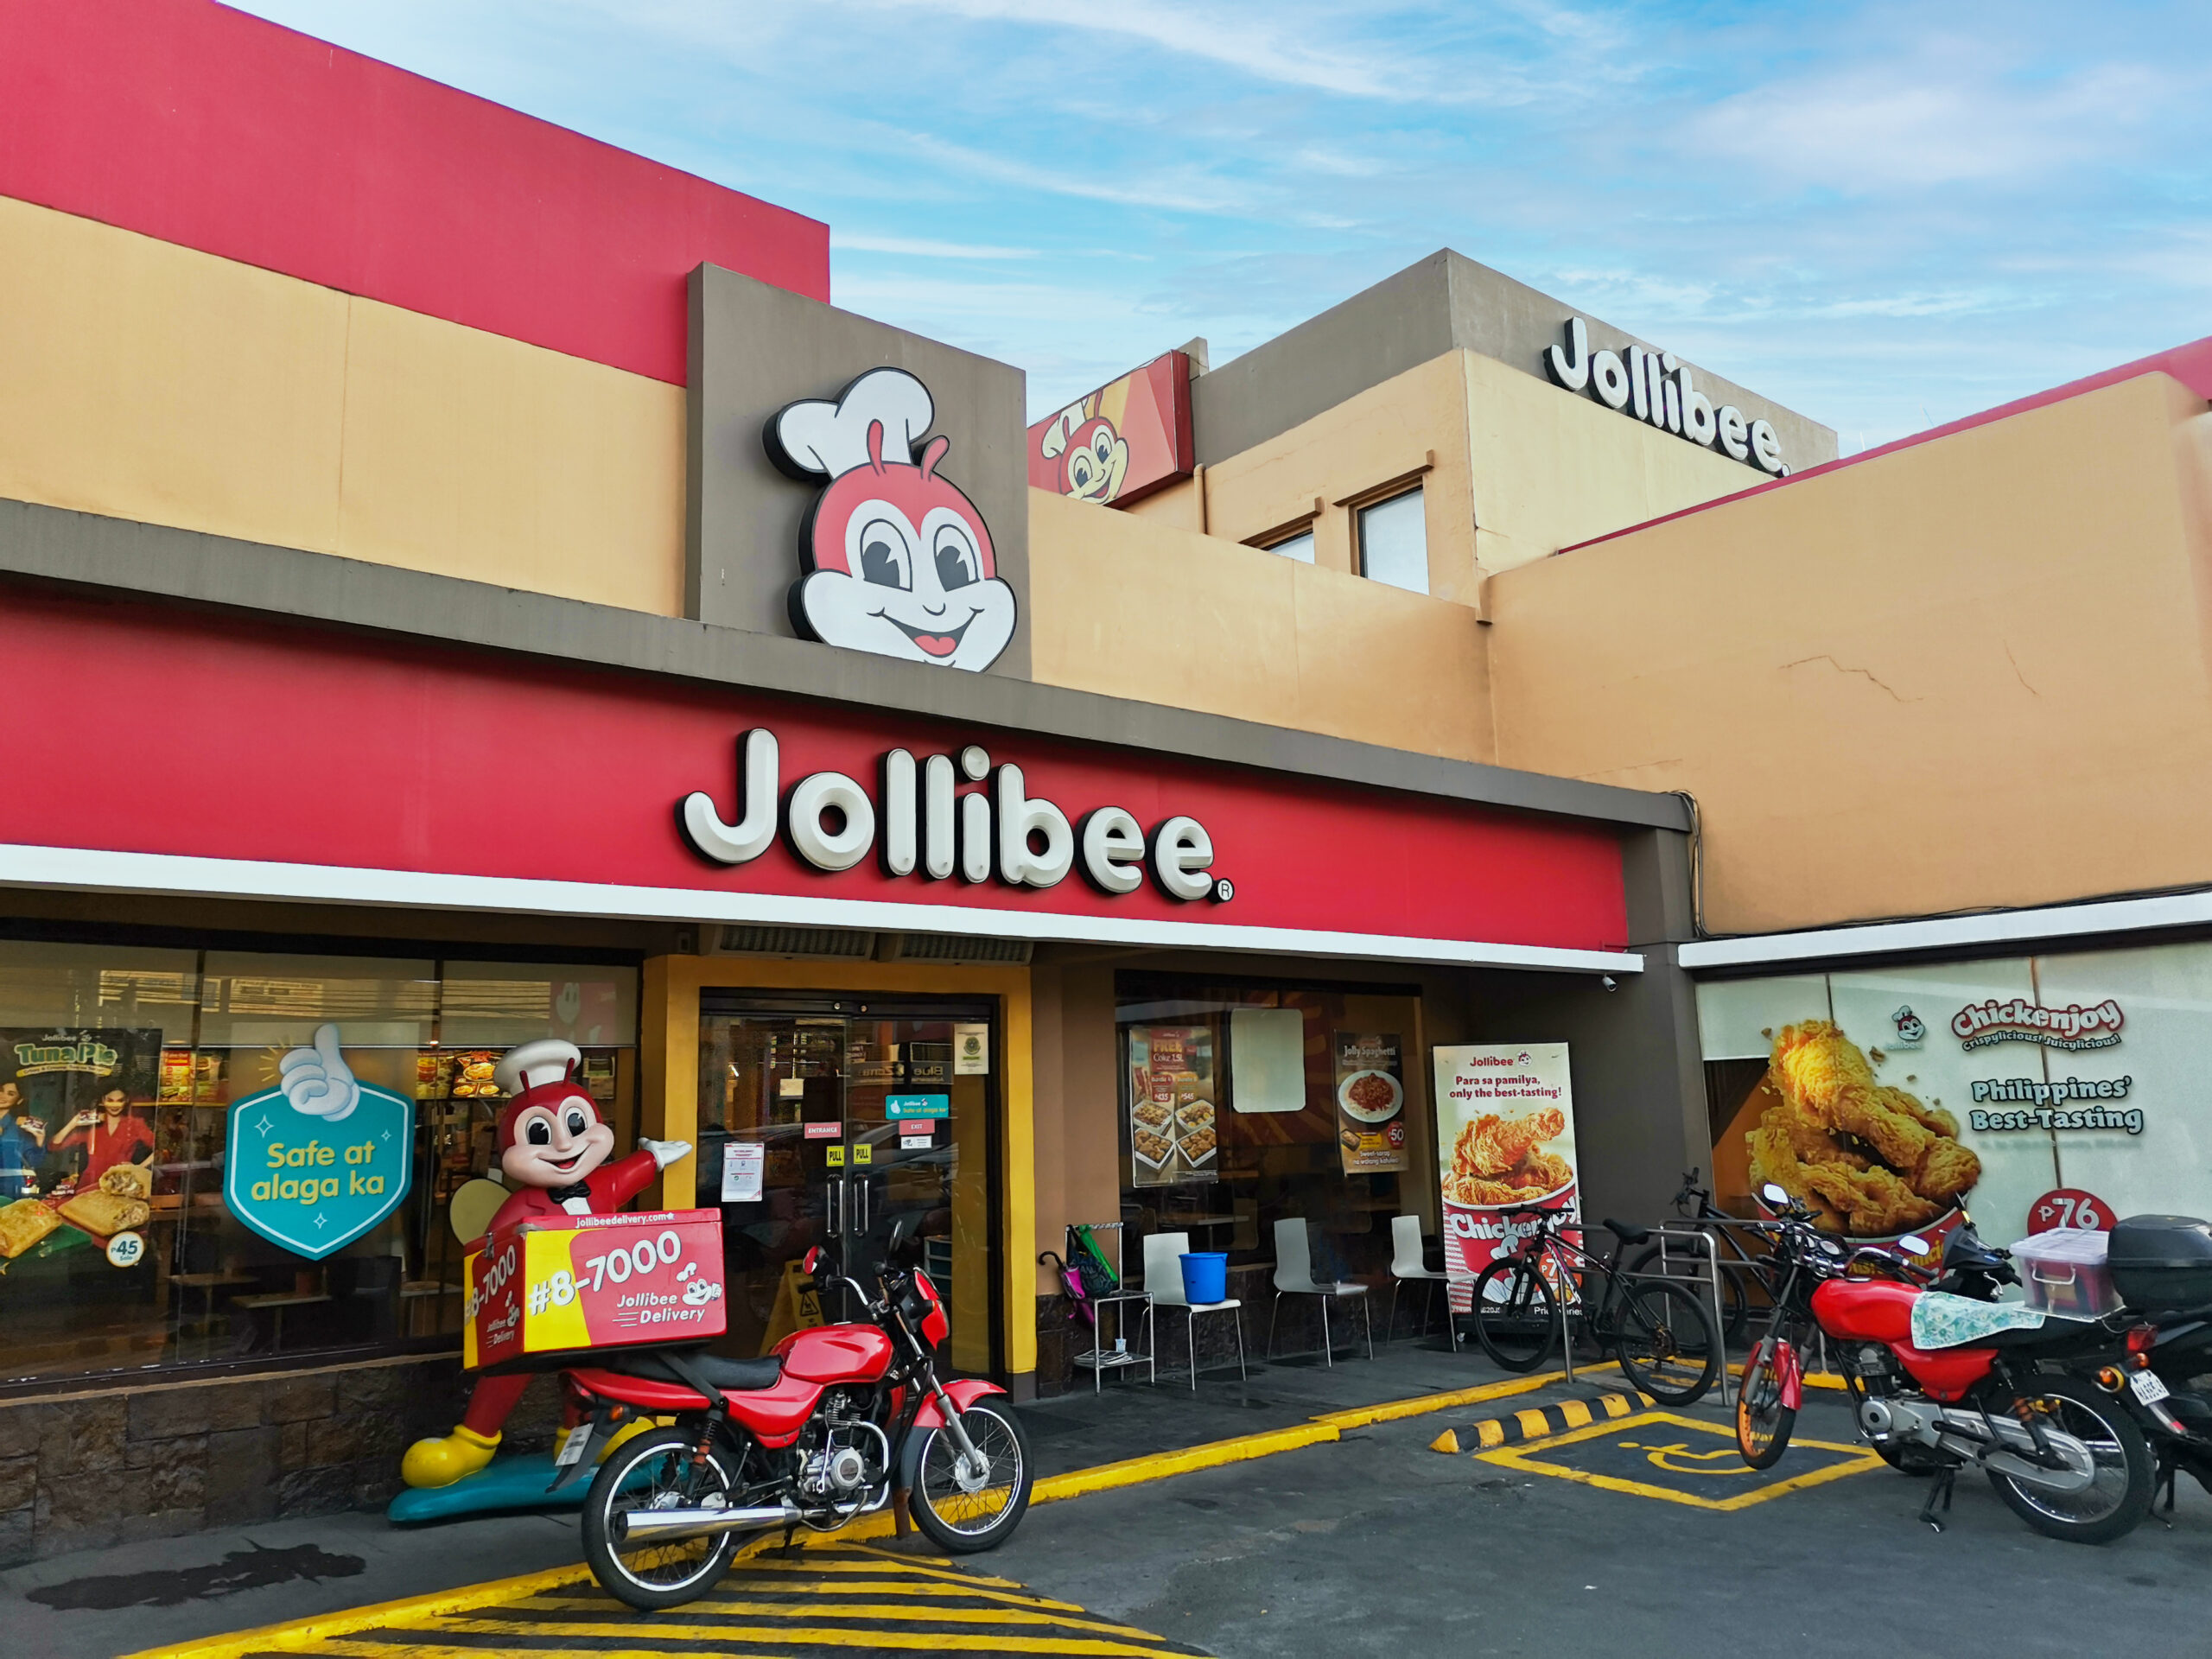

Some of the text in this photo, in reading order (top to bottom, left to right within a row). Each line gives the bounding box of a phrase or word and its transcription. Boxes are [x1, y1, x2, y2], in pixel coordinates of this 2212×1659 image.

[1544, 316, 1783, 474] Jollibee
[677, 728, 1214, 900] Jollibee
[1952, 999, 2124, 1039] Chickenjoy
[1962, 1030, 2122, 1052] Crispylicious! Juicylicious!
[14, 1042, 118, 1066] Tuna Pie
[1344, 1045, 1396, 1058] Jolly Spaghetti
[1470, 1056, 1514, 1066] Jollibee
[1456, 1076, 1479, 1085] Para
[1495, 1075, 1541, 1087] pamilya,
[1971, 1075, 2133, 1106] Philippines'
[1449, 1087, 1561, 1100] only the best-tasting!
[1970, 1107, 2144, 1135] Best-Tasting
[266, 1140, 376, 1168] Safe at
[830, 1150, 842, 1161] PULL
[855, 1148, 869, 1159] PULL
[251, 1169, 385, 1205] alaga ka
[575, 1213, 667, 1228] jollibeedelivery.com
[528, 1230, 682, 1316] #8-7000
[617, 1292, 678, 1308] Jollibee
[639, 1307, 706, 1325] Delivery
[493, 1329, 515, 1345] Delivery
